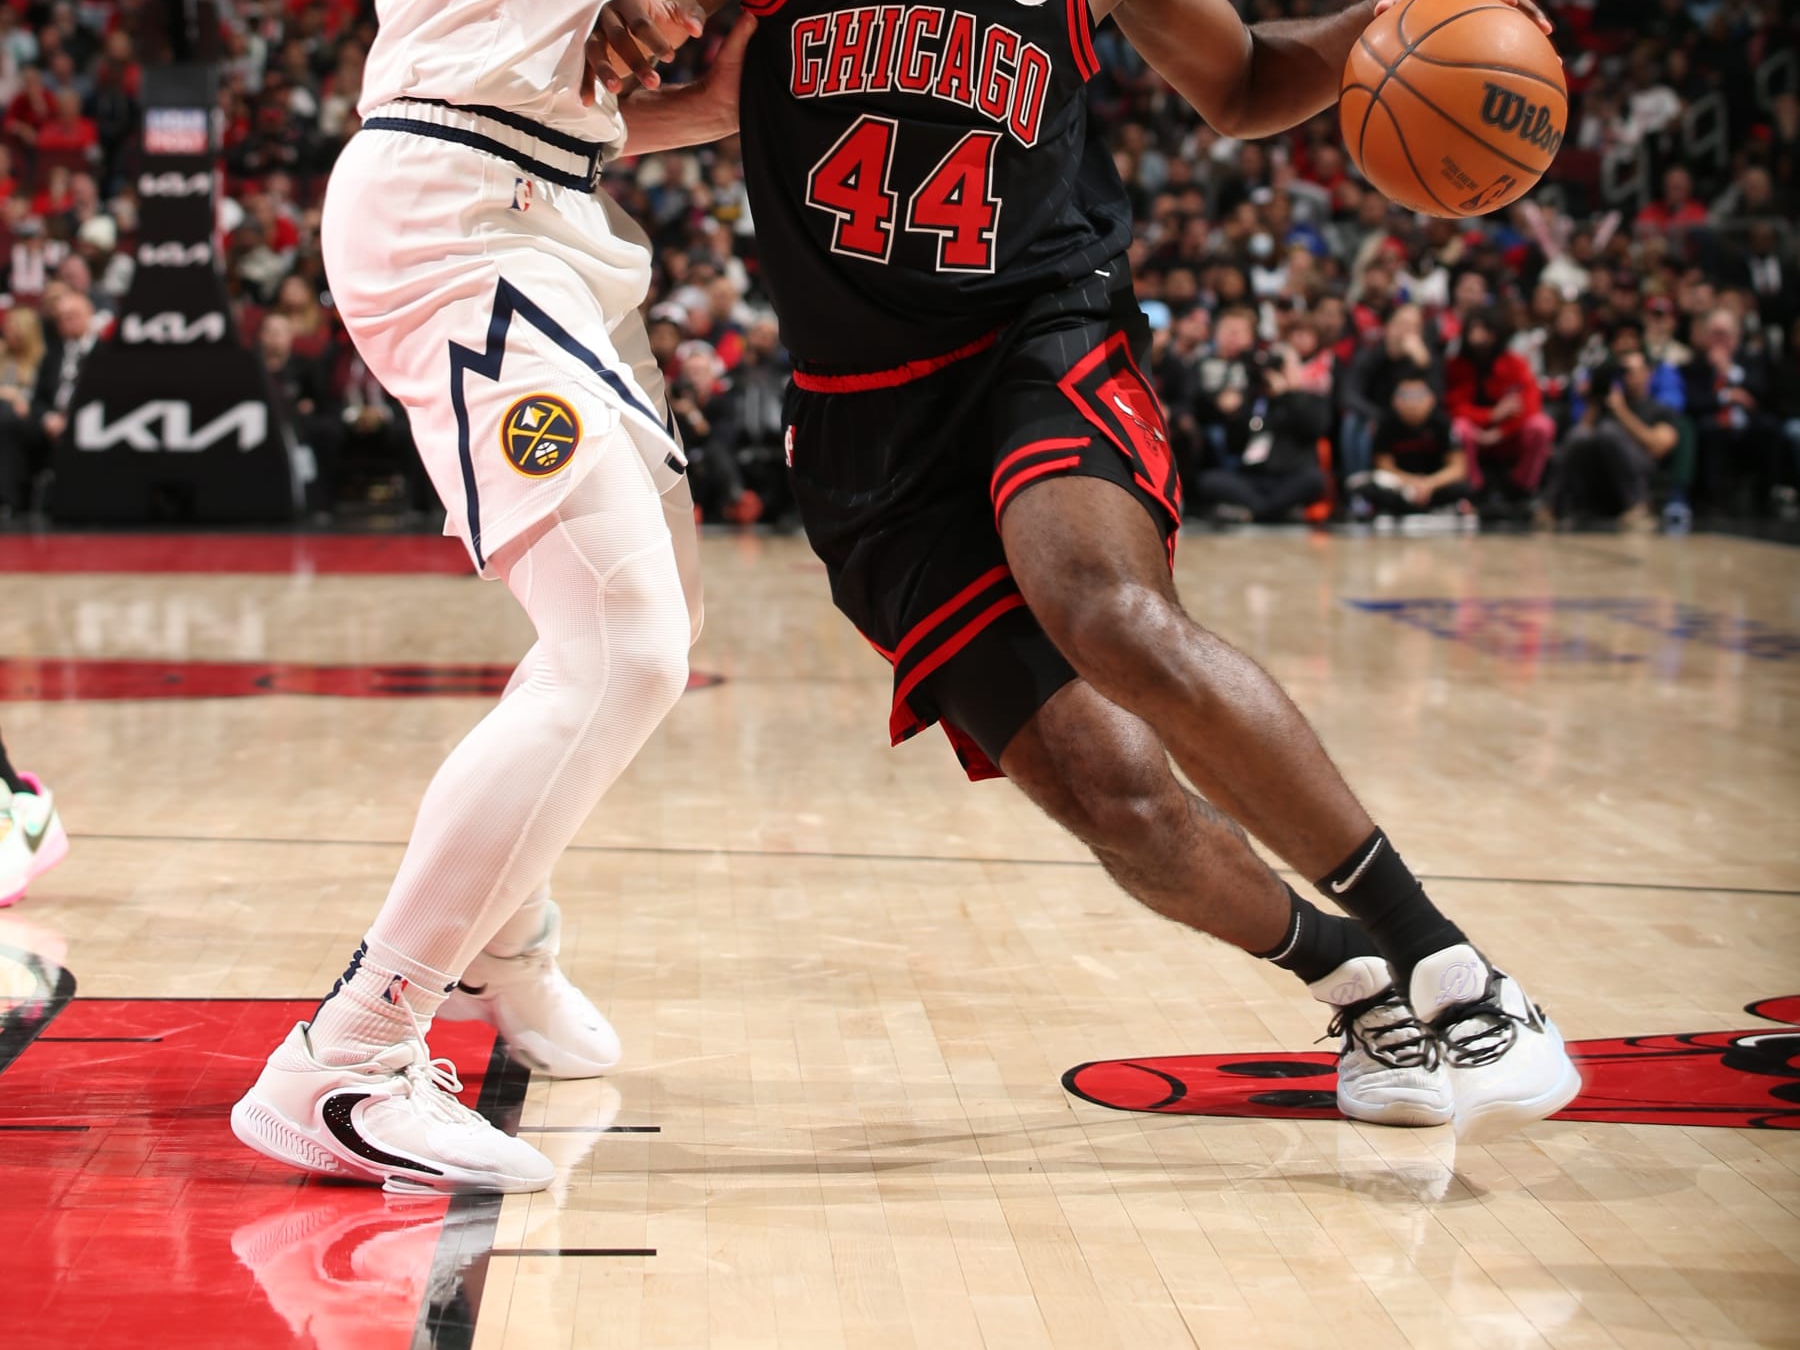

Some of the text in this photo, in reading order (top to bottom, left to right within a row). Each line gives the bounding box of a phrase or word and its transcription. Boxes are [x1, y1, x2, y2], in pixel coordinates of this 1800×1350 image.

[790, 5, 1052, 149] CHICAGO
[1481, 81, 1563, 156] Wilso
[805, 114, 1003, 274] 44
[121, 311, 225, 343] KIA
[74, 400, 267, 452] KIA
